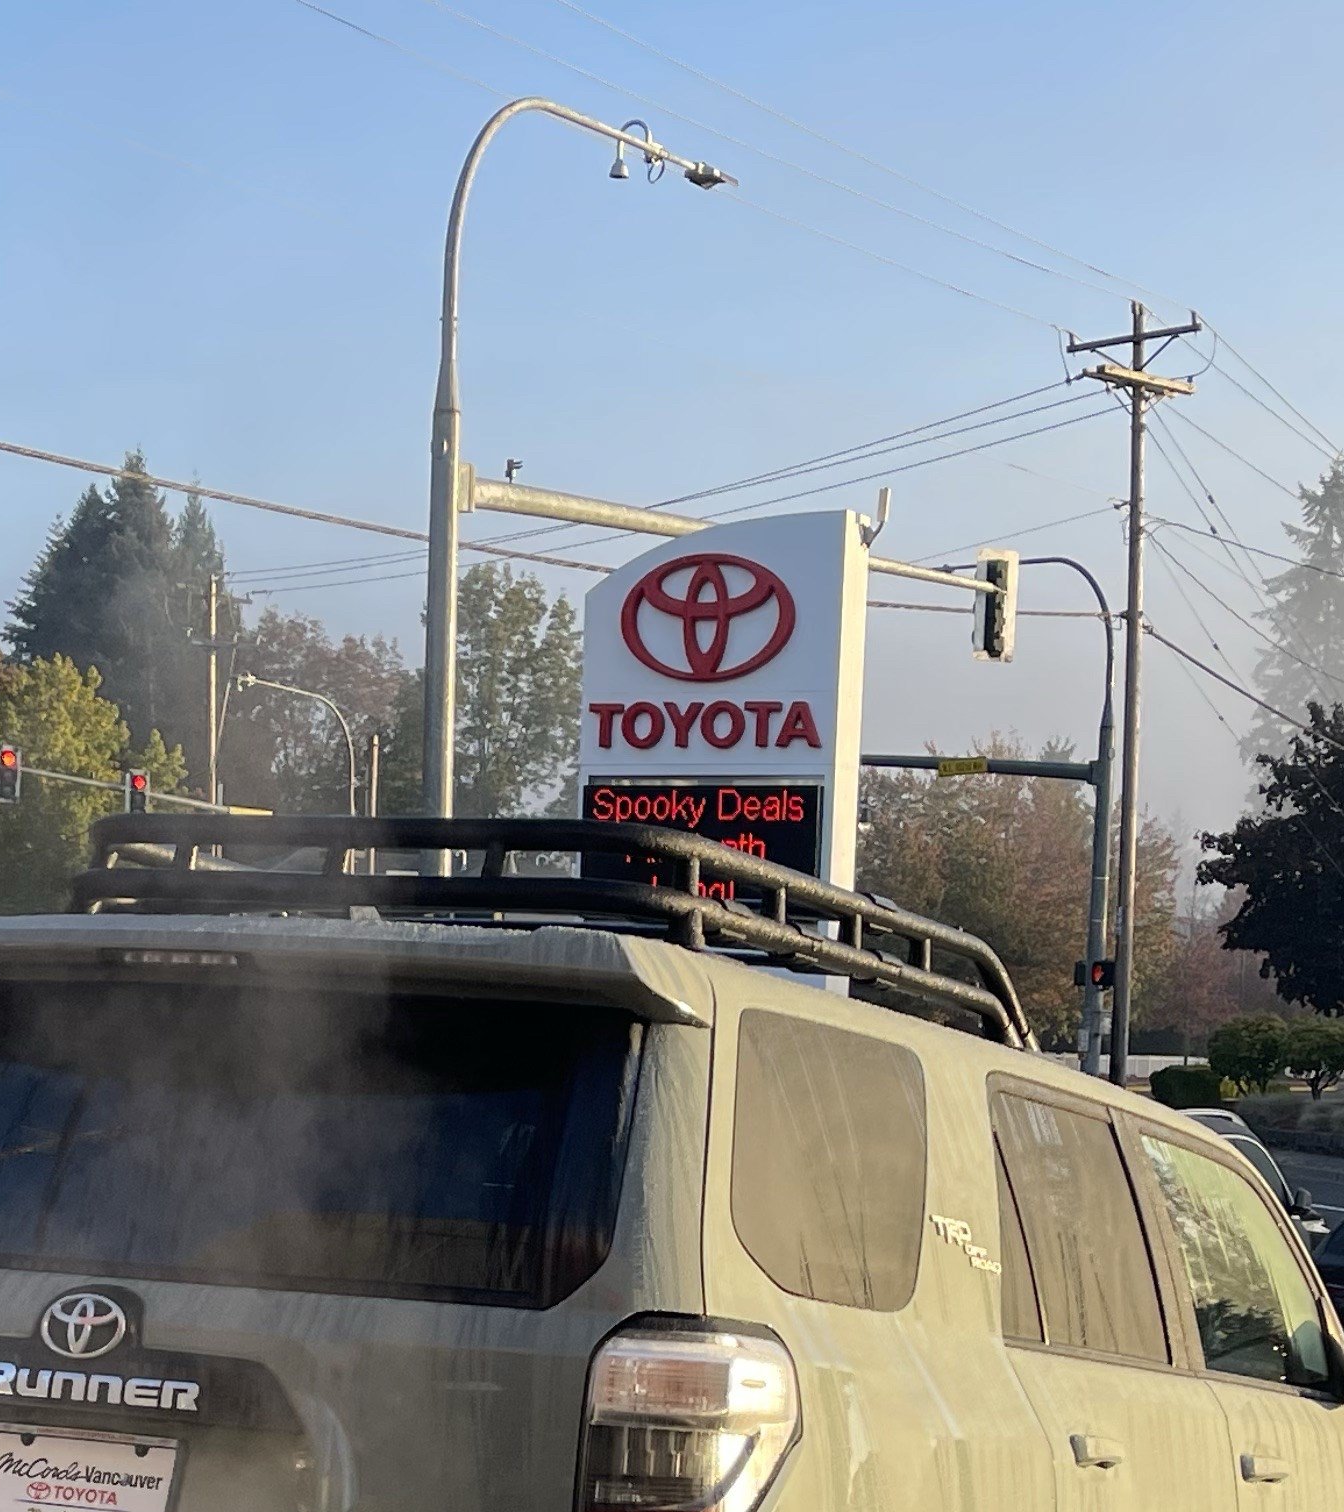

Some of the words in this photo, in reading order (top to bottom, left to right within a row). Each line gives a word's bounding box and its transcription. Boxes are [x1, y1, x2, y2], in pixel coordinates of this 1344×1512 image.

[589, 700, 822, 749] TOYOTA
[592, 788, 706, 828] Spooky
[717, 788, 805, 822] Deals
[83, 1464, 163, 1491] Vancouver
[54, 1485, 118, 1505] TOYOTA
